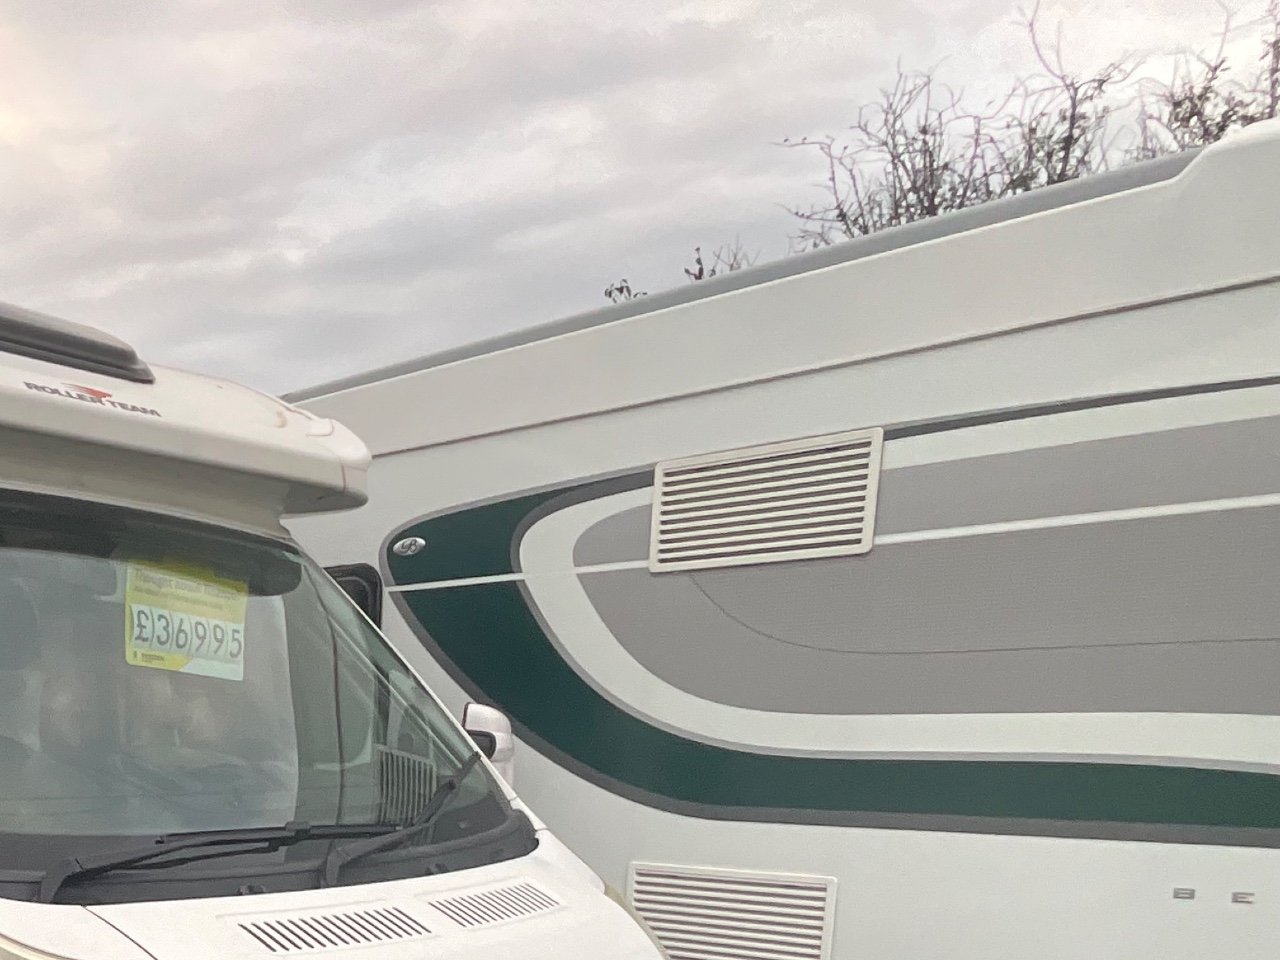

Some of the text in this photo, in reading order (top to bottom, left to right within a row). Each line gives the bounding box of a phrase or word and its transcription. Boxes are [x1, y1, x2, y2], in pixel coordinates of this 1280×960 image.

[23, 381, 162, 417] ROLLER TEAM
[134, 609, 242, 658] £36995
